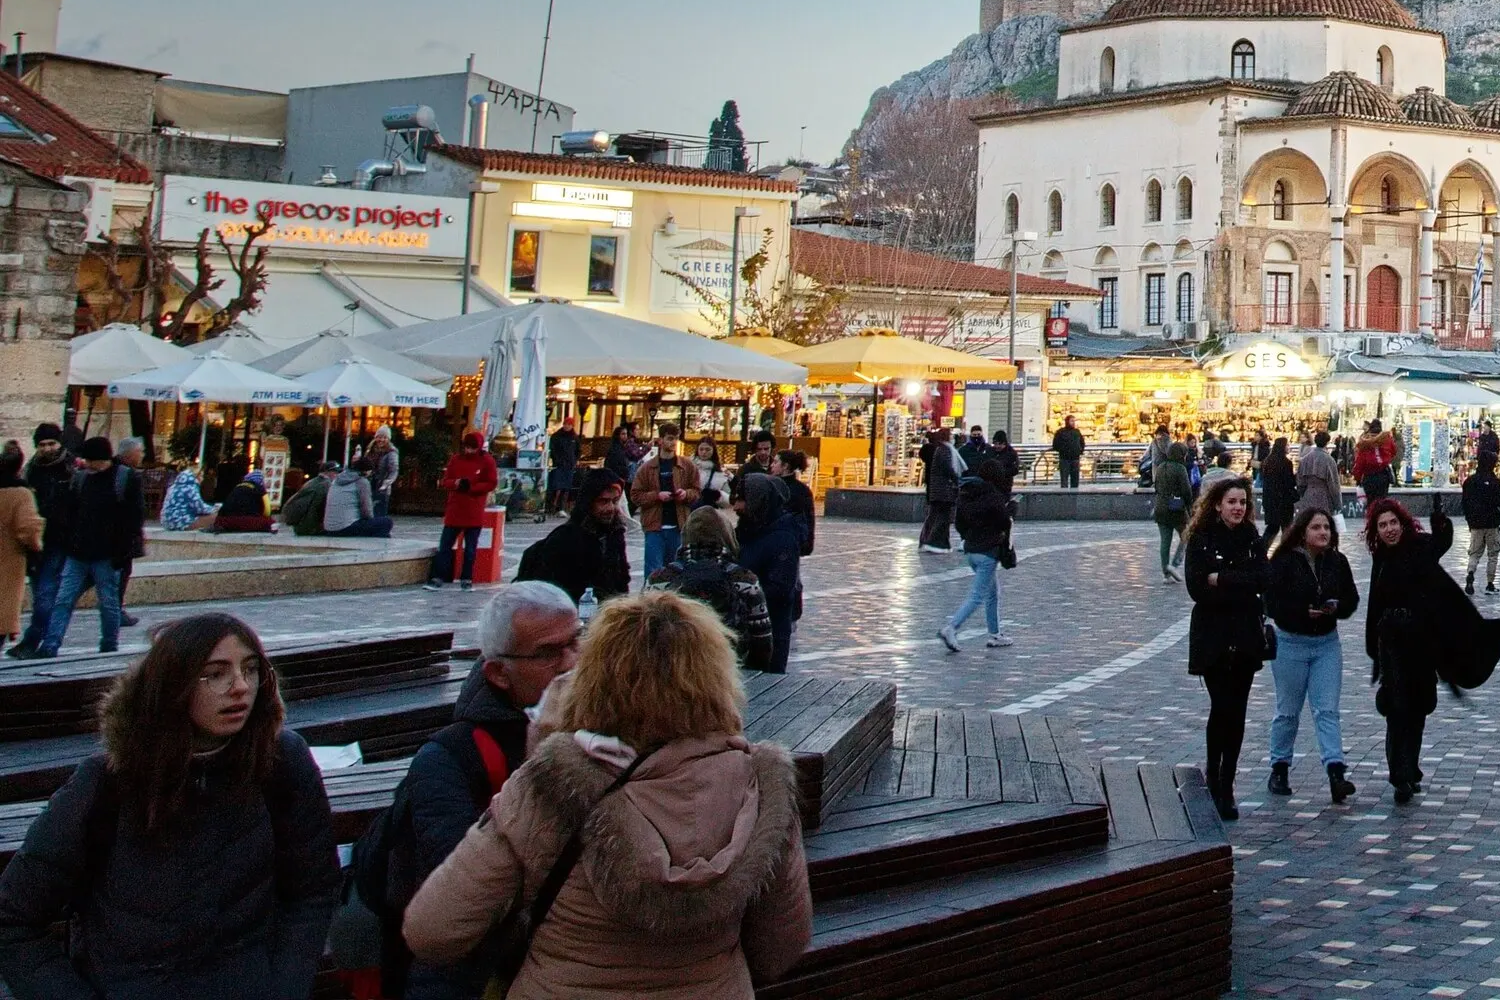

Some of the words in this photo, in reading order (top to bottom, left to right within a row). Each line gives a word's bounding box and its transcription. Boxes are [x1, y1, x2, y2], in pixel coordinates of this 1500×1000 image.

[204, 191, 249, 214] the
[256, 199, 350, 222] greco's
[355, 205, 442, 230] project
[682, 261, 733, 273] GREEK
[1007, 319, 1031, 329] TAVEL
[927, 365, 955, 374] Lagom
[252, 391, 273, 399] ATM
[276, 391, 302, 400] HERE
[395, 396, 413, 404] ATM
[417, 396, 440, 405] HERE
